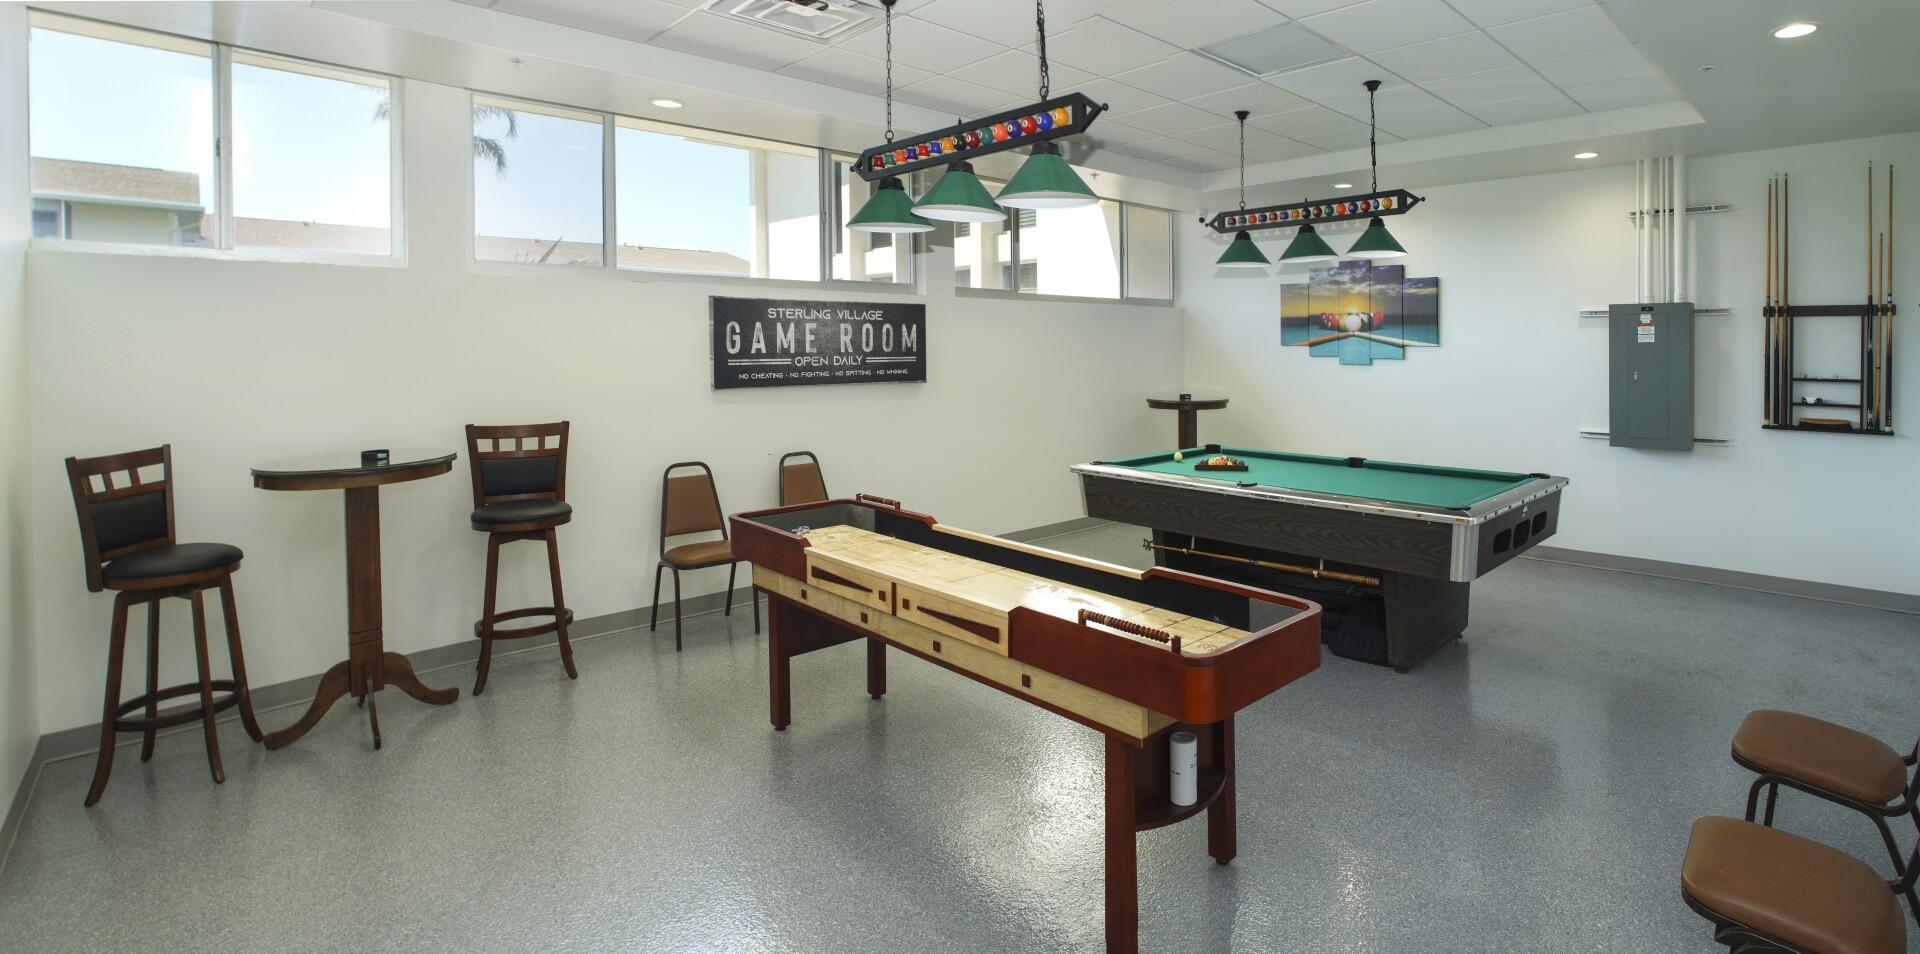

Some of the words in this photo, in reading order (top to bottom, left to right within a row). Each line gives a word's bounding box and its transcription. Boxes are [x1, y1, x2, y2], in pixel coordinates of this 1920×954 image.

[768, 308, 831, 319] STERLING
[837, 310, 883, 321] VILLAGE
[726, 321, 817, 354] GAME
[840, 323, 917, 353] ROOM
[794, 356, 829, 367] OPEN
[833, 355, 863, 366] DAILY
[751, 372, 783, 380] CHEATING
